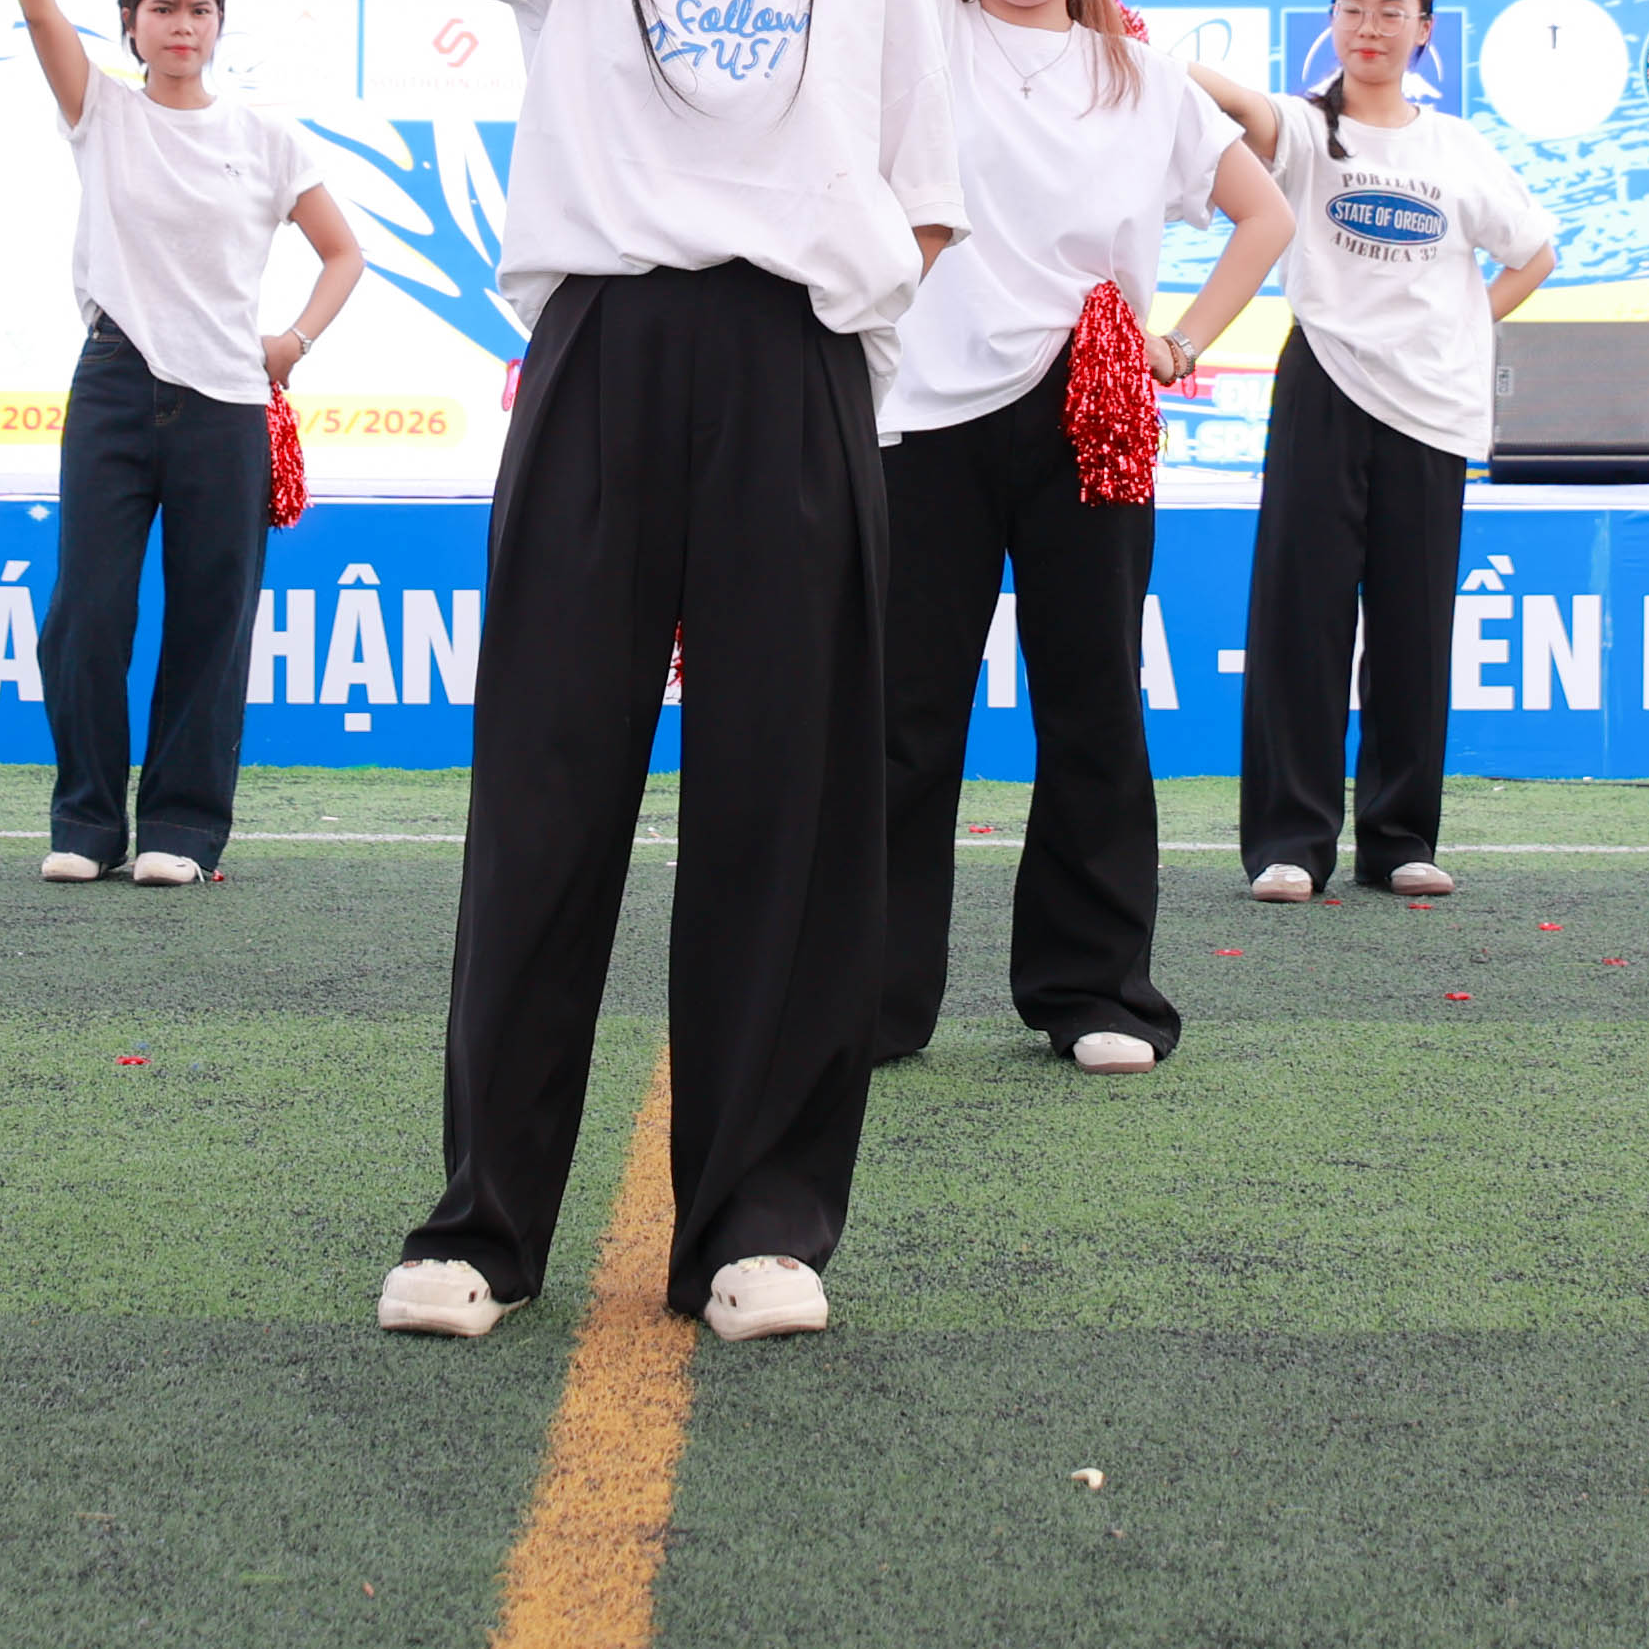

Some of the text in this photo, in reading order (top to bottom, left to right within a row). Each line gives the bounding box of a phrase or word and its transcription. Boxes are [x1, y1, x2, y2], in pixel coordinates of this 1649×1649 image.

[1342, 172, 1441, 200] PORTLAND
[1334, 201, 1442, 235] STATE OF OREGON
[1331, 231, 1413, 262] AMERICA
[246, 563, 482, 732] HẬN
